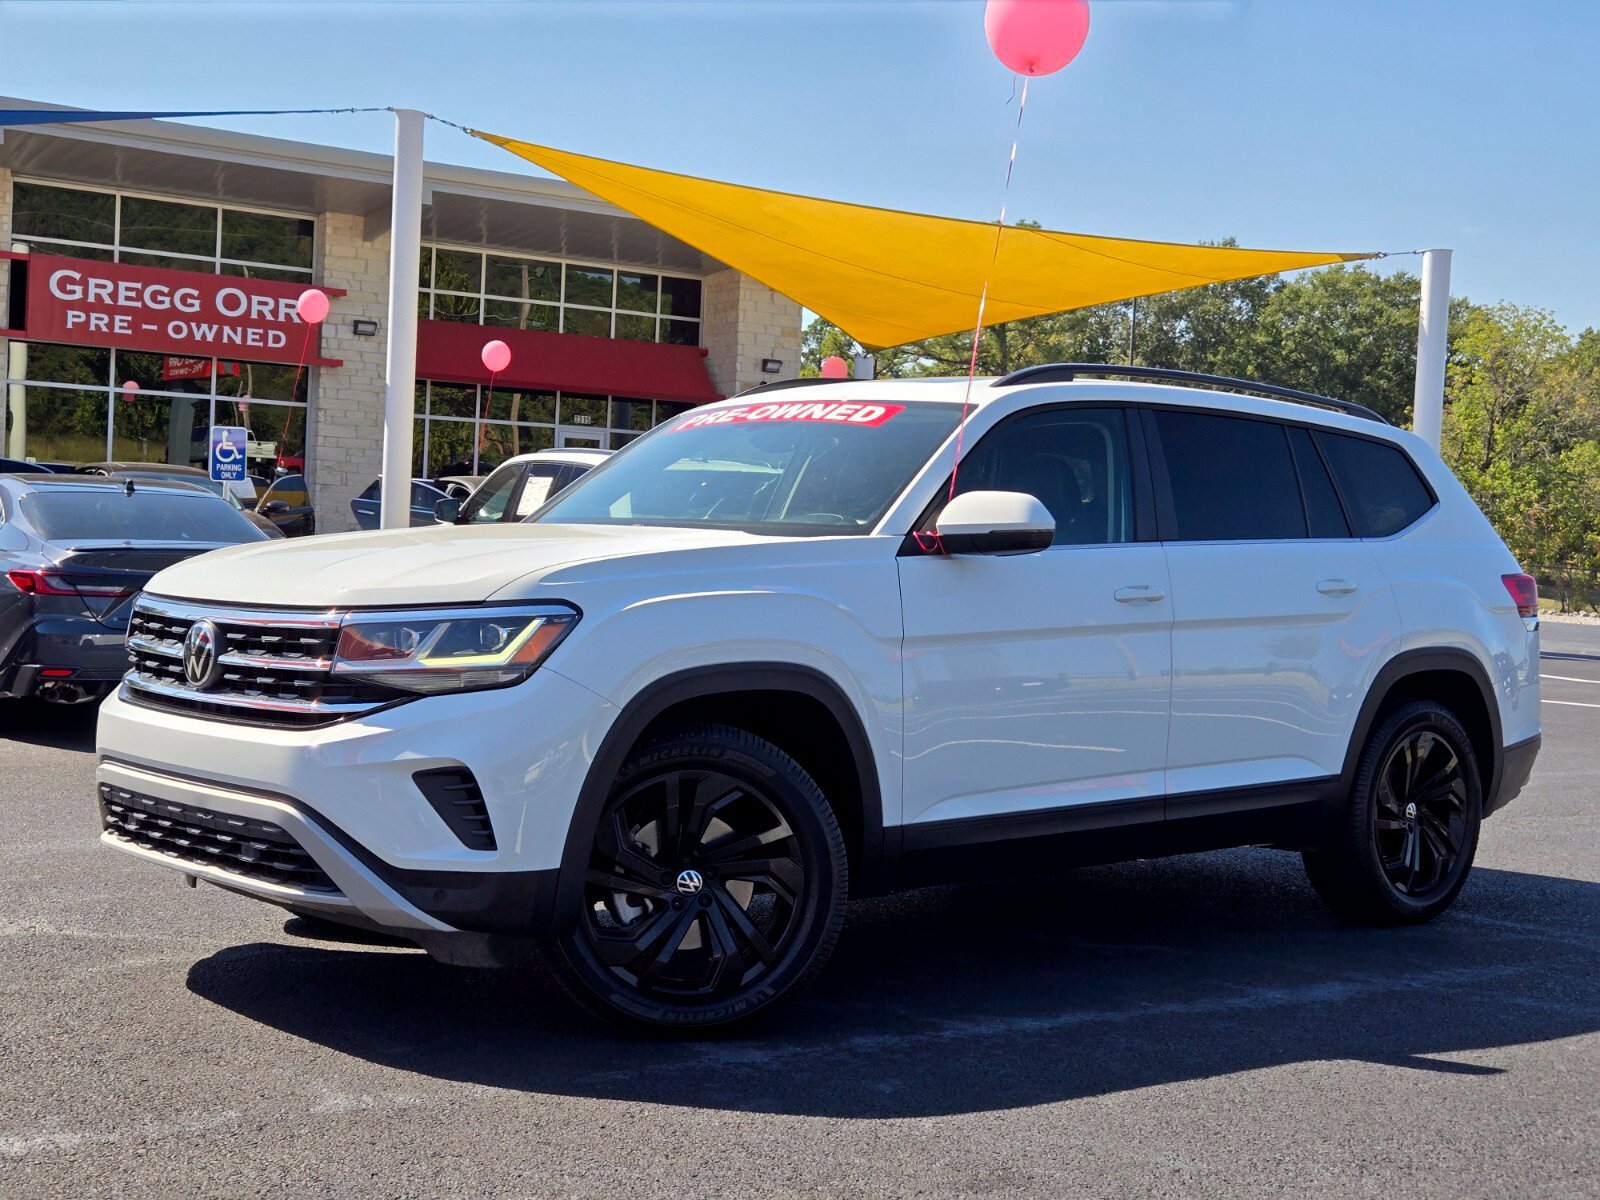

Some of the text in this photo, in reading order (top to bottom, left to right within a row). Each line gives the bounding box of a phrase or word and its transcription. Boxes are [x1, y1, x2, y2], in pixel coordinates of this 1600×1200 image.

[49, 269, 302, 324] GREGG ORR
[66, 310, 133, 335] PRE
[167, 320, 287, 348] OWNED
[675, 403, 887, 431] PRE-OWNED
[216, 463, 242, 471] PARKING
